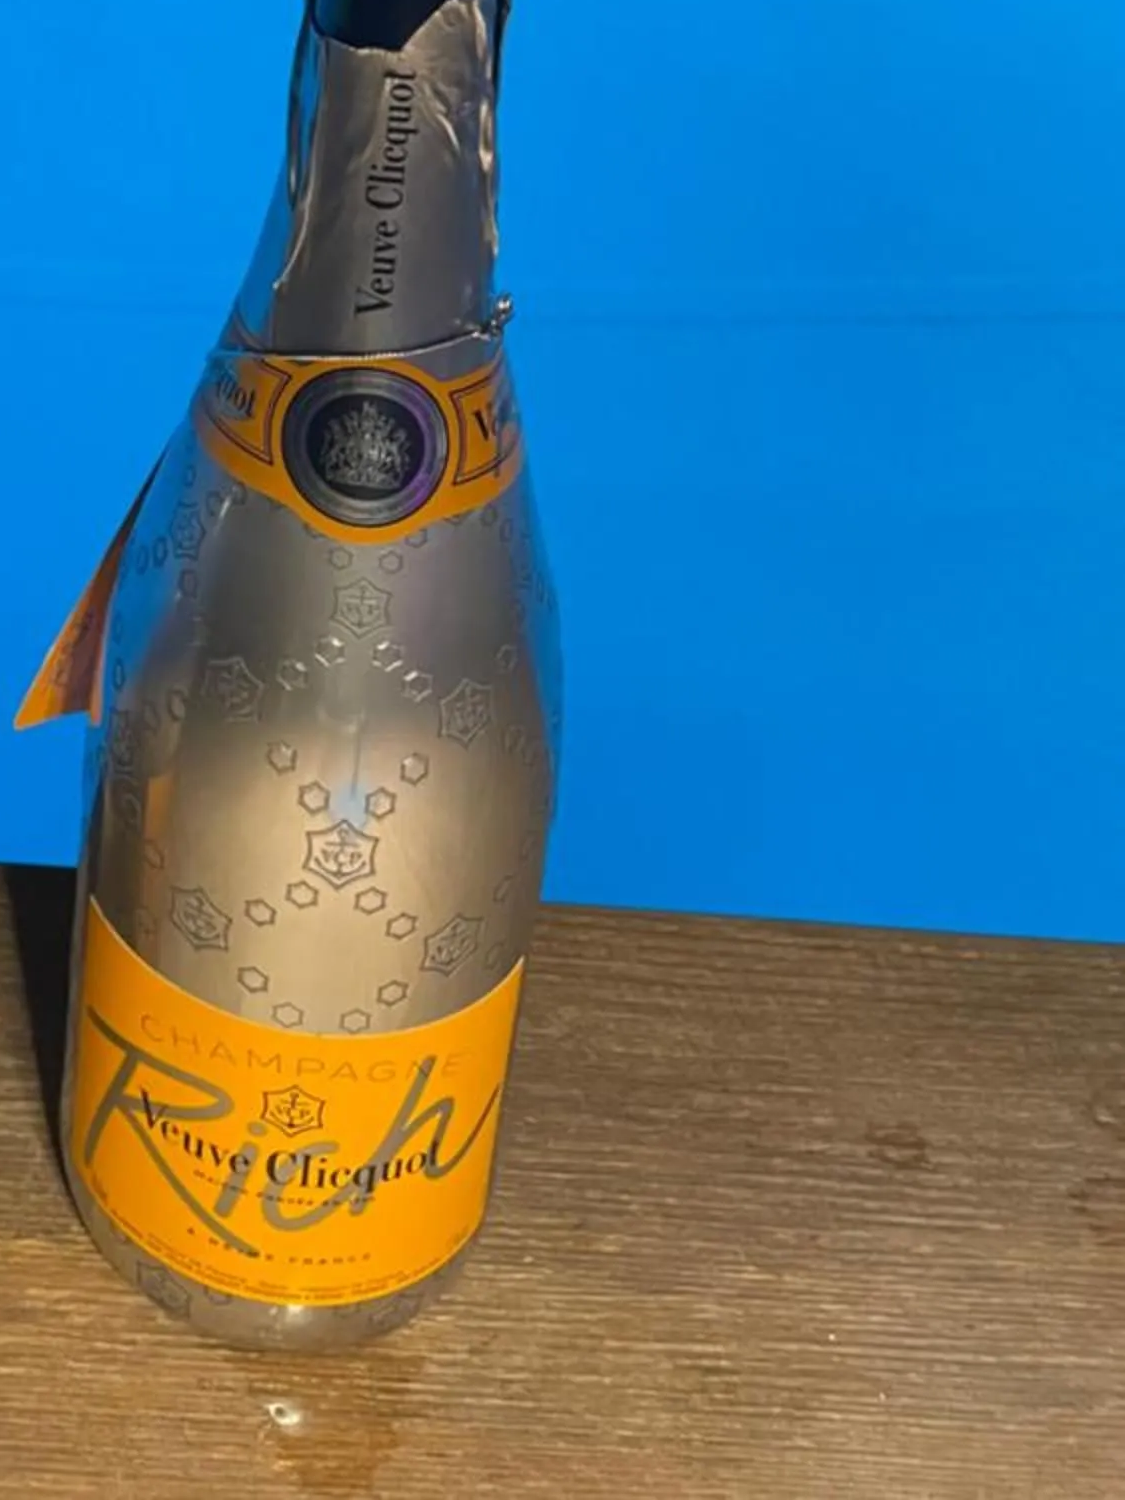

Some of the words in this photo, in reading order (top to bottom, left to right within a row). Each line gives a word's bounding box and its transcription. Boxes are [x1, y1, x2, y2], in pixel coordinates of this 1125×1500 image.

[365, 69, 419, 211] Clicquot
[353, 220, 398, 316] Veuve
[140, 1014, 465, 1083] CHAMPAGNE
[83, 1004, 502, 1259] Rich
[139, 1086, 251, 1174] Veuve
[265, 1140, 442, 1204] Clicquot
